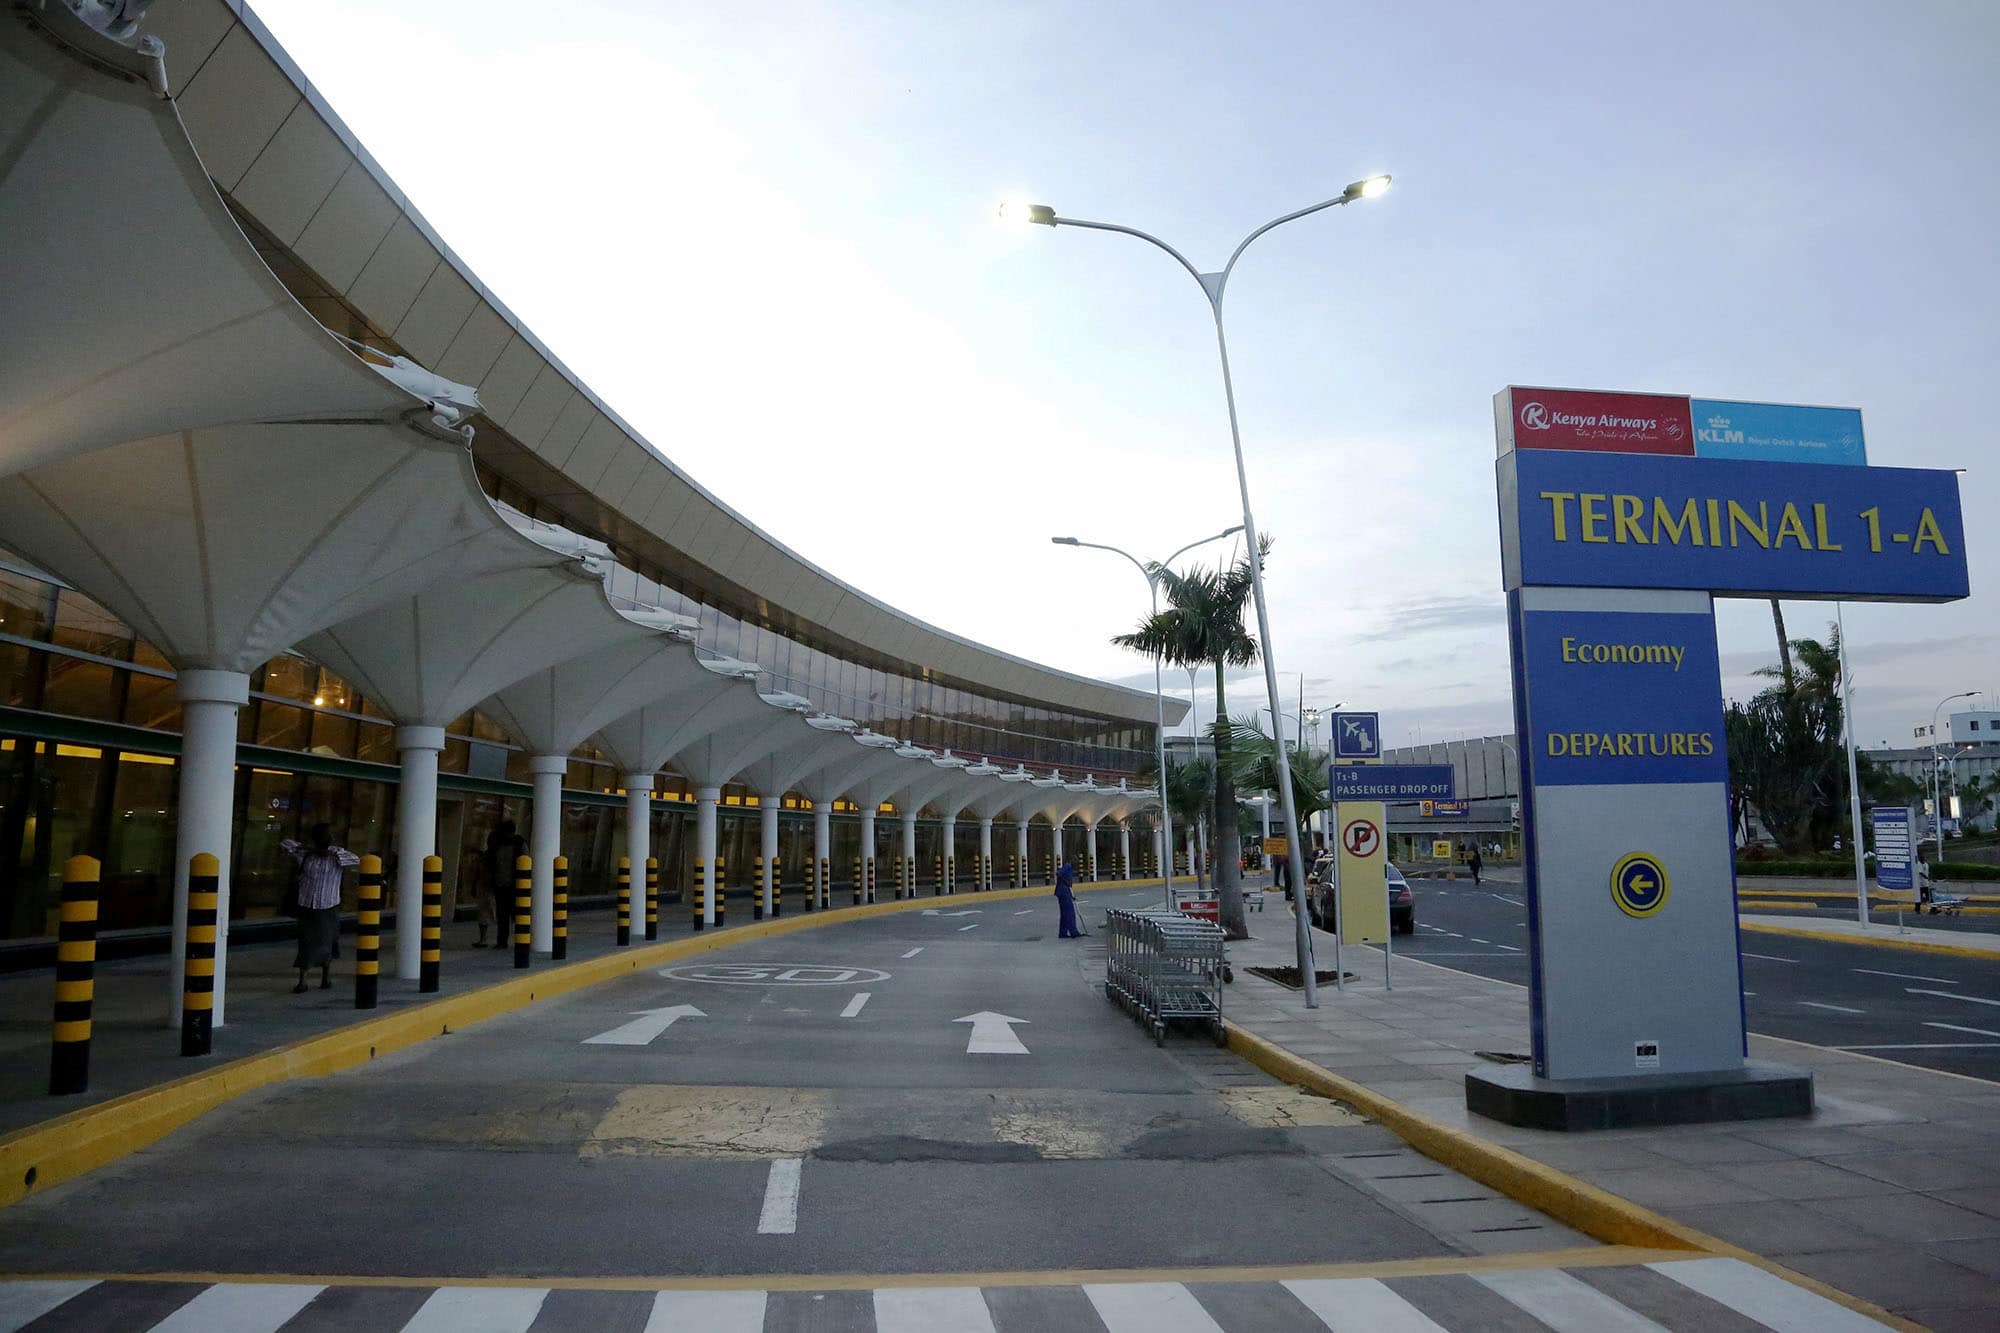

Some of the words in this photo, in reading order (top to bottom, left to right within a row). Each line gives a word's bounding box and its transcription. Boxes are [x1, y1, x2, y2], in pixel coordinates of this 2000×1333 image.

[1552, 412, 1595, 427] Kenya
[1598, 414, 1657, 431] Airways
[1698, 429, 1744, 443] KLM
[1540, 491, 1842, 551] TERMINAL
[1858, 506, 1950, 555] 1-A
[1561, 637, 1685, 672] Economy
[1548, 732, 1714, 757] DEPARTURES
[1335, 772, 1358, 781] T1-B
[1336, 785, 1397, 794] PASSENGER
[1400, 785, 1428, 794] DROP
[1430, 784, 1449, 793] OFF
[691, 966, 859, 981] 30
